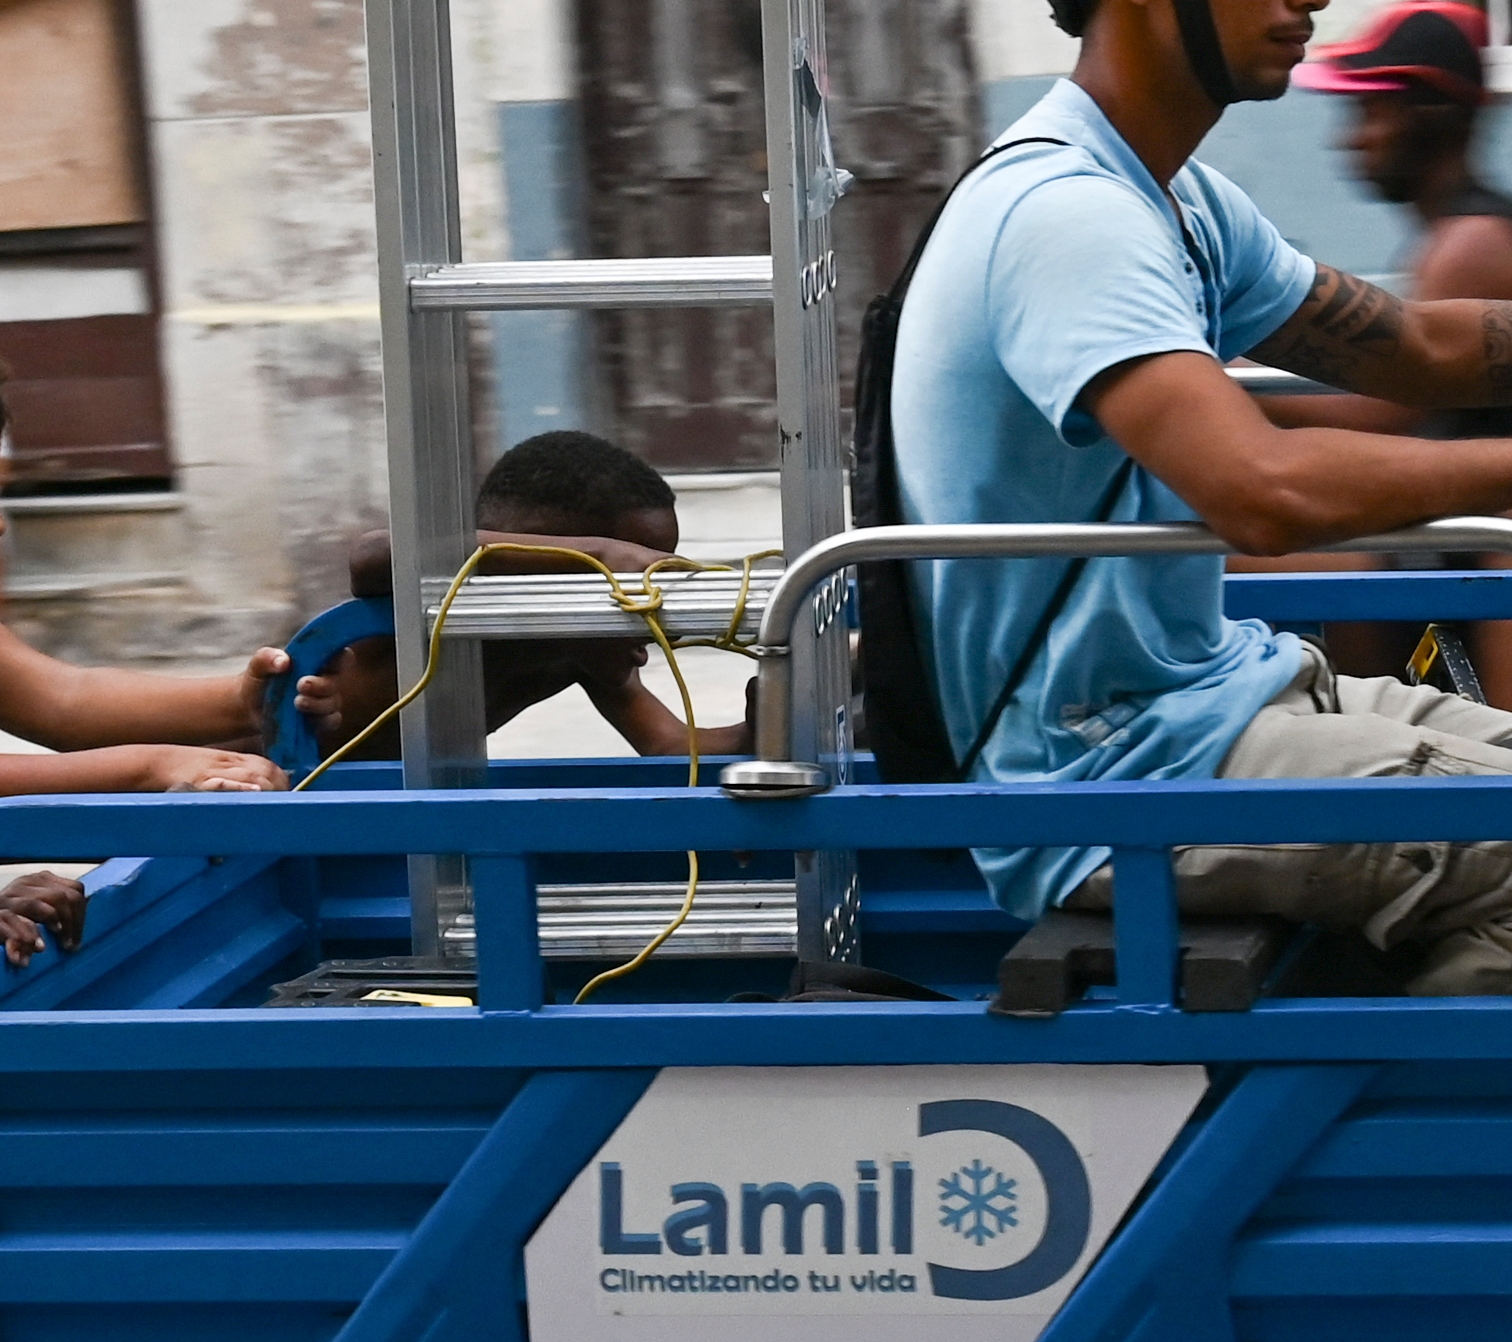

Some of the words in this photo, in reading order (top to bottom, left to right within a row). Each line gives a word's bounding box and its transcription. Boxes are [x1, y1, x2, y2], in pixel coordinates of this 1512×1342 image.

[599, 1160, 915, 1257] Lamil
[599, 1267, 800, 1294] Climatizando
[808, 1271, 844, 1294] tu
[850, 1267, 917, 1294] vida
